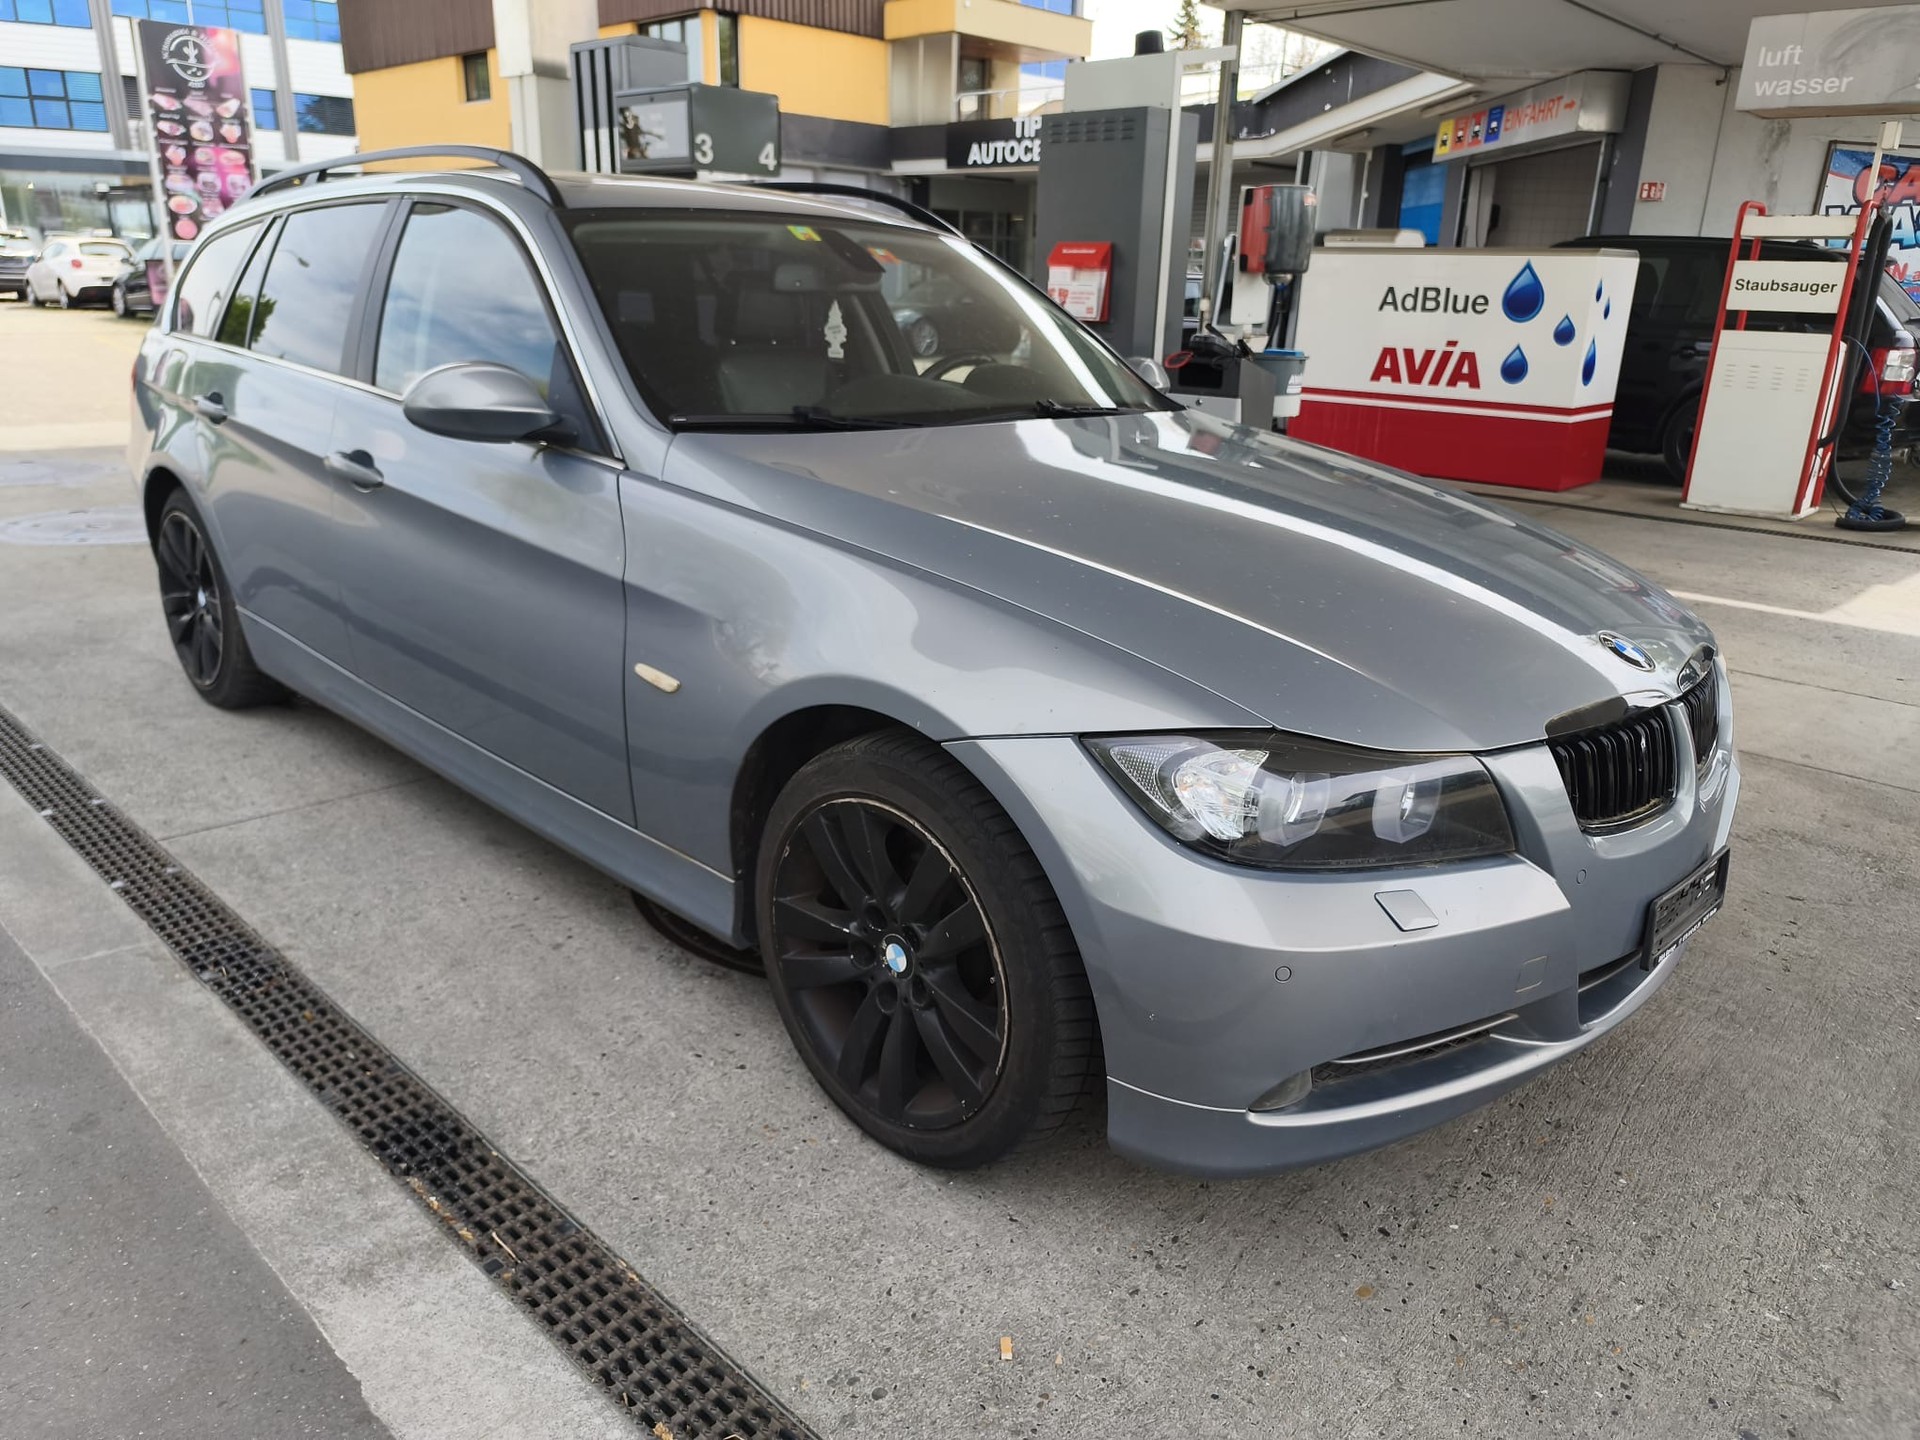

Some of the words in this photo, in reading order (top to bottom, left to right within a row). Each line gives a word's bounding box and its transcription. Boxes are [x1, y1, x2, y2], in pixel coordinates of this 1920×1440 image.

[1758, 44, 1803, 67] luft
[1755, 75, 1854, 97] wasser
[1503, 95, 1564, 132] EINFAHRT
[694, 133, 714, 164] 3
[758, 142, 778, 171] 4
[1734, 278, 1838, 296] Staubsauger
[1378, 286, 1490, 315] AdBlue
